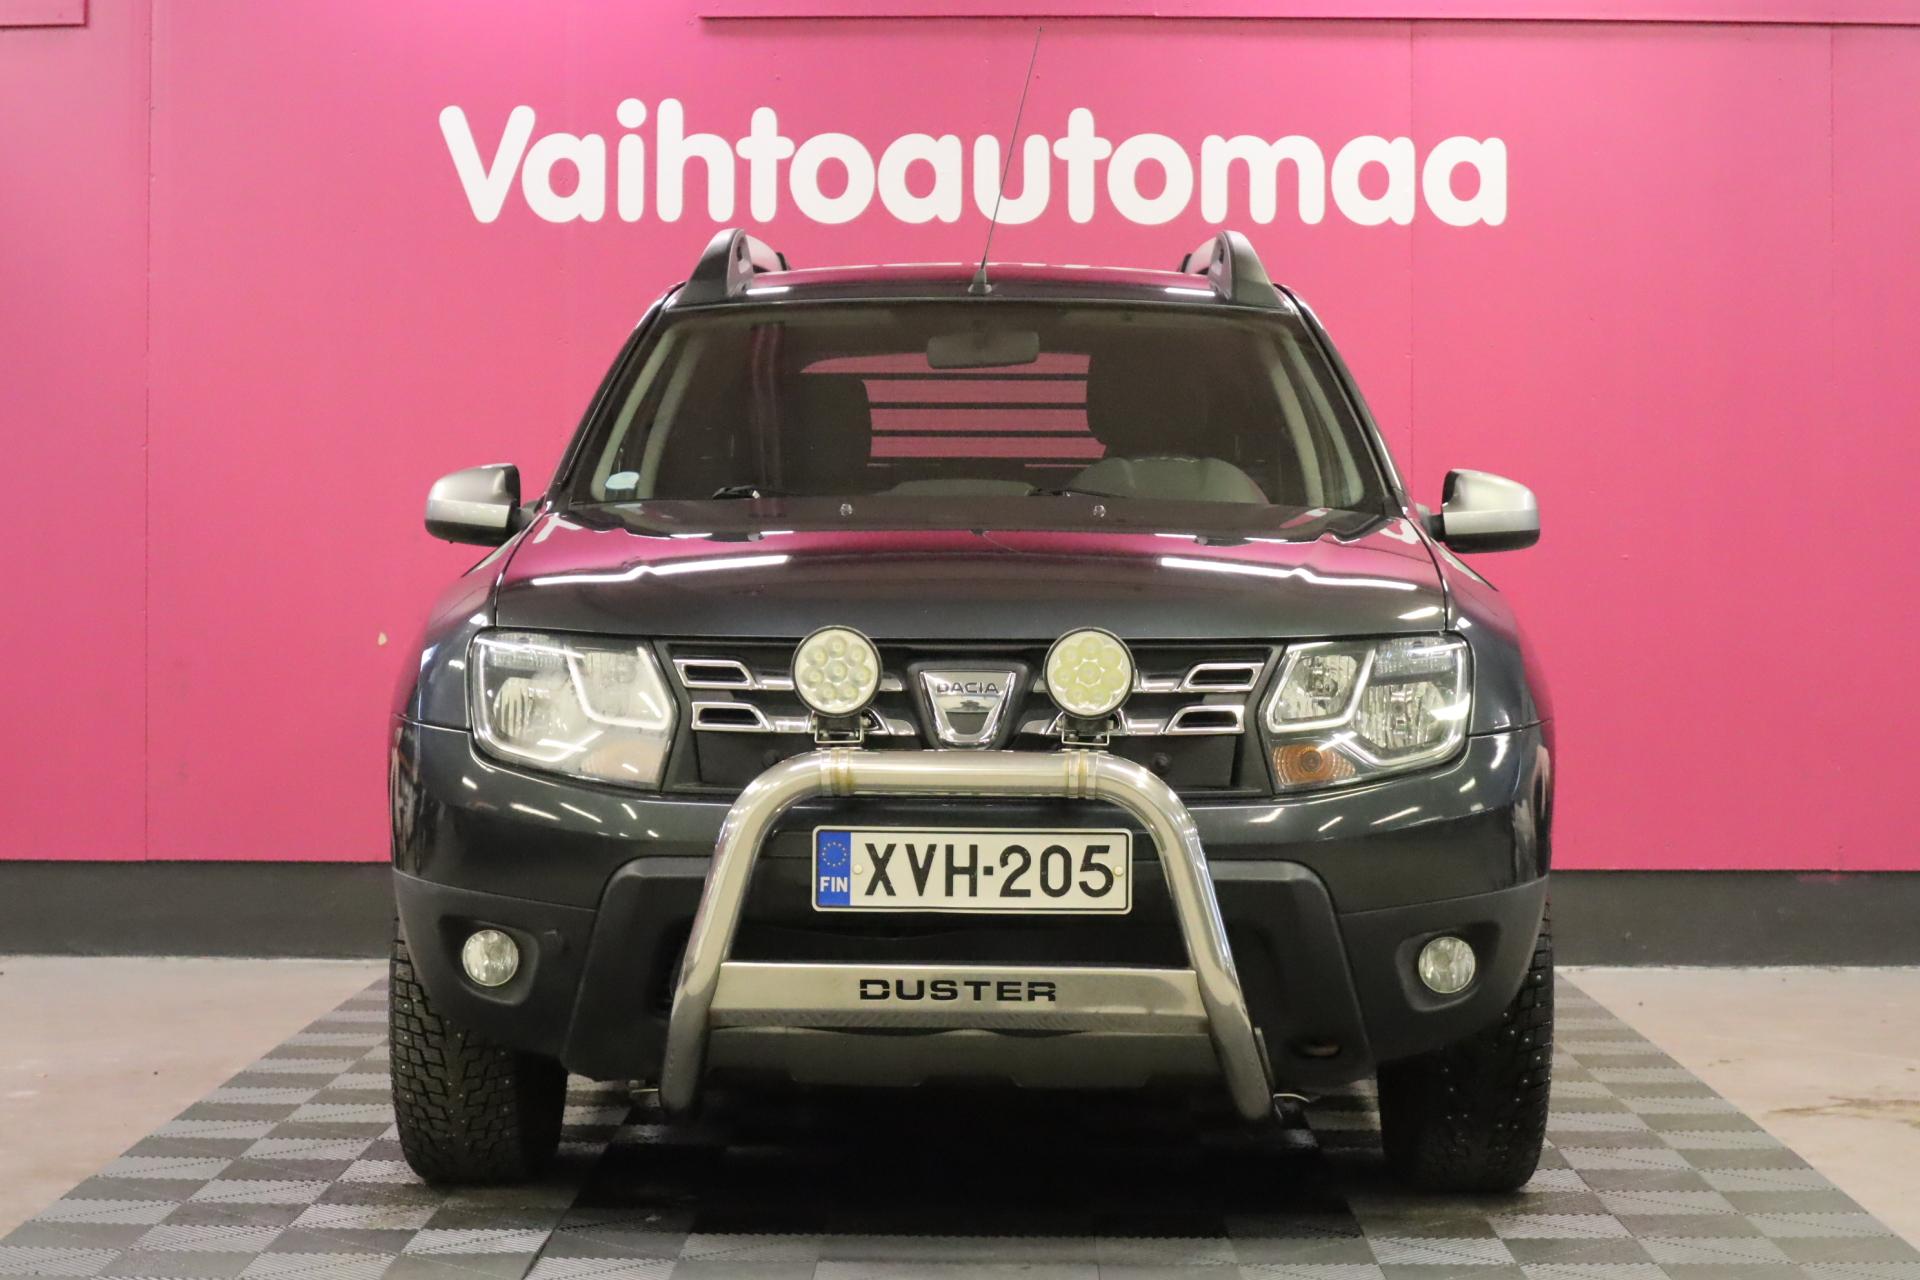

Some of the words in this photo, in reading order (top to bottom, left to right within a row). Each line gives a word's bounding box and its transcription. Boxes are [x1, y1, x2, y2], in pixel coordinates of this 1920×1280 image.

[439, 97, 1507, 228] Vaihtoautomaa
[936, 682, 999, 694] DACIA
[864, 843, 1115, 898] XVH-205
[819, 876, 848, 893] FIN
[859, 979, 1057, 1002] DUSTER
